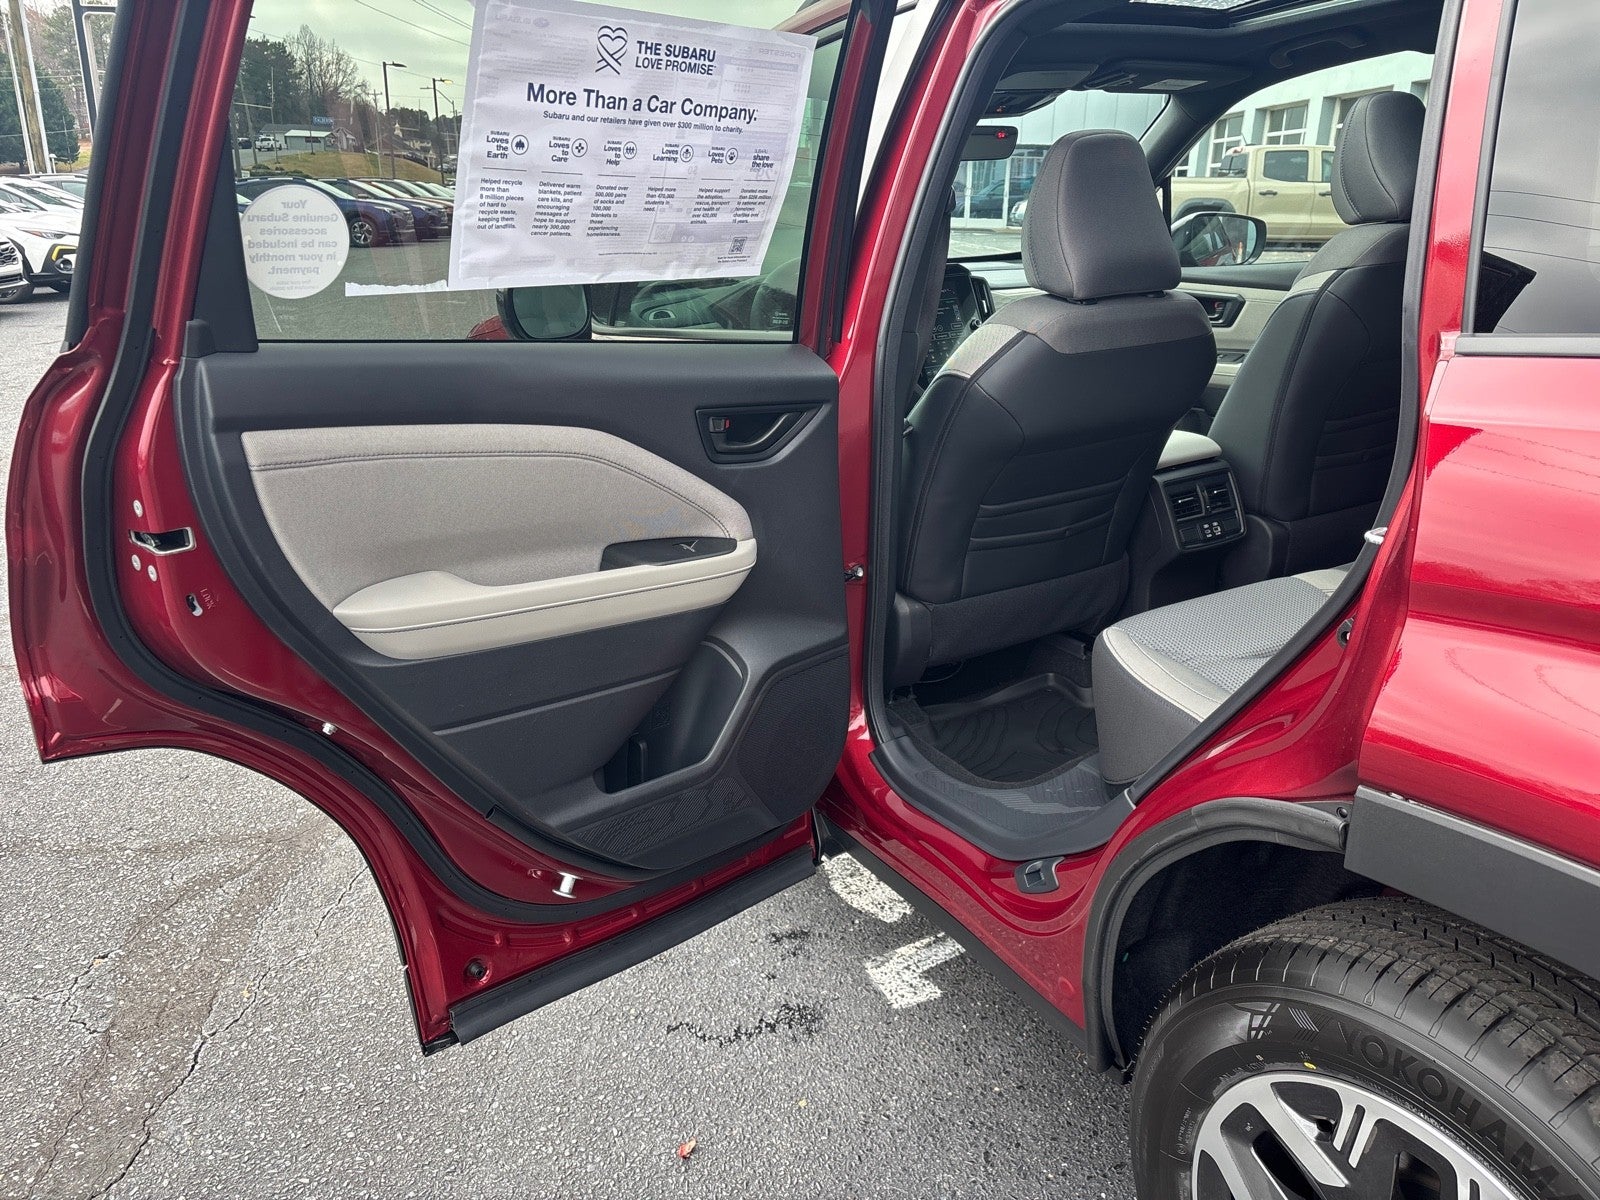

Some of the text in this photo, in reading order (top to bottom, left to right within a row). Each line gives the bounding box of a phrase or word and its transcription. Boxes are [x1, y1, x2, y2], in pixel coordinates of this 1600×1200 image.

[637, 41, 716, 63] THE SUBARU
[635, 57, 714, 76] LOVE PROMISE
[527, 82, 757, 125] More Than a Car Company.
[543, 111, 570, 120] Subaru
[600, 116, 627, 125] retailers
[628, 118, 642, 126] have
[644, 119, 661, 128] given
[677, 121, 692, 129] $300
[694, 123, 713, 131] million
[722, 126, 743, 135] charity.
[487, 135, 509, 144] Loves
[549, 141, 570, 149] Loves
[487, 151, 508, 159] Earth
[653, 154, 678, 163] Learning
[1337, 1021, 1587, 1200] YOKOHAM
